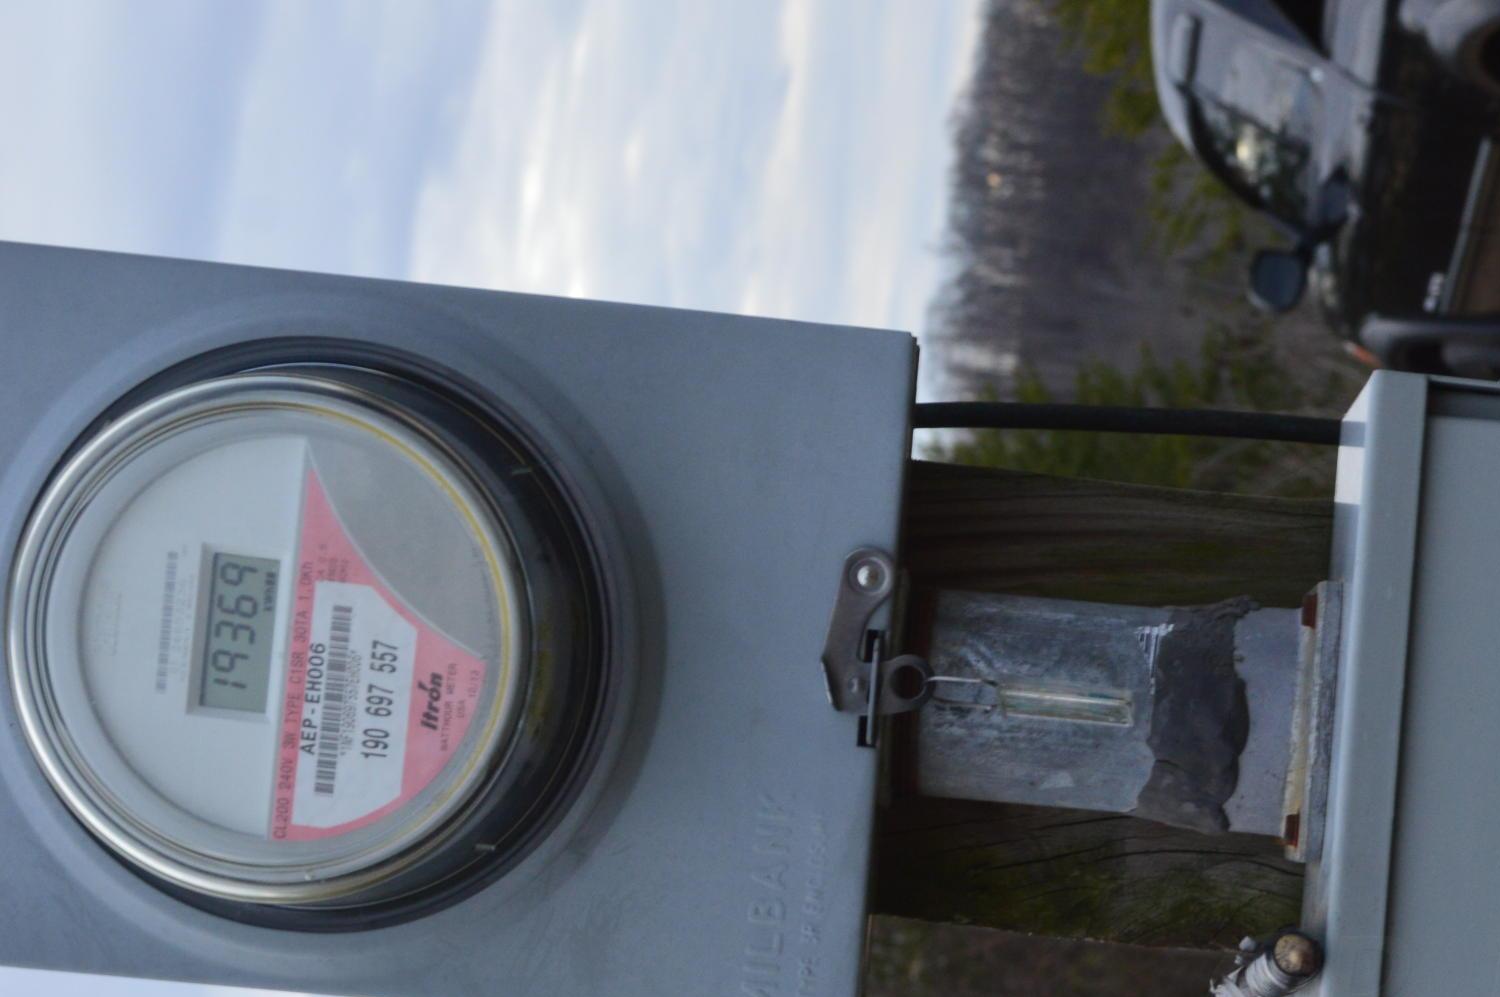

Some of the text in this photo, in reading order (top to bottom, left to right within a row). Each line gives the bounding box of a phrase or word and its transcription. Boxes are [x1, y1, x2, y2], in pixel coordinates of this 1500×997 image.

[211, 562, 259, 690] 19369
[290, 652, 304, 684] C1SR
[285, 691, 299, 722] TYPE
[299, 642, 325, 756] AEP-EH006
[360, 639, 398, 760] 190 697 557
[440, 663, 457, 752] WATTHOUR METER
[283, 732, 296, 749] 3W
[279, 758, 293, 790] 240V
[272, 797, 289, 840] CL200
